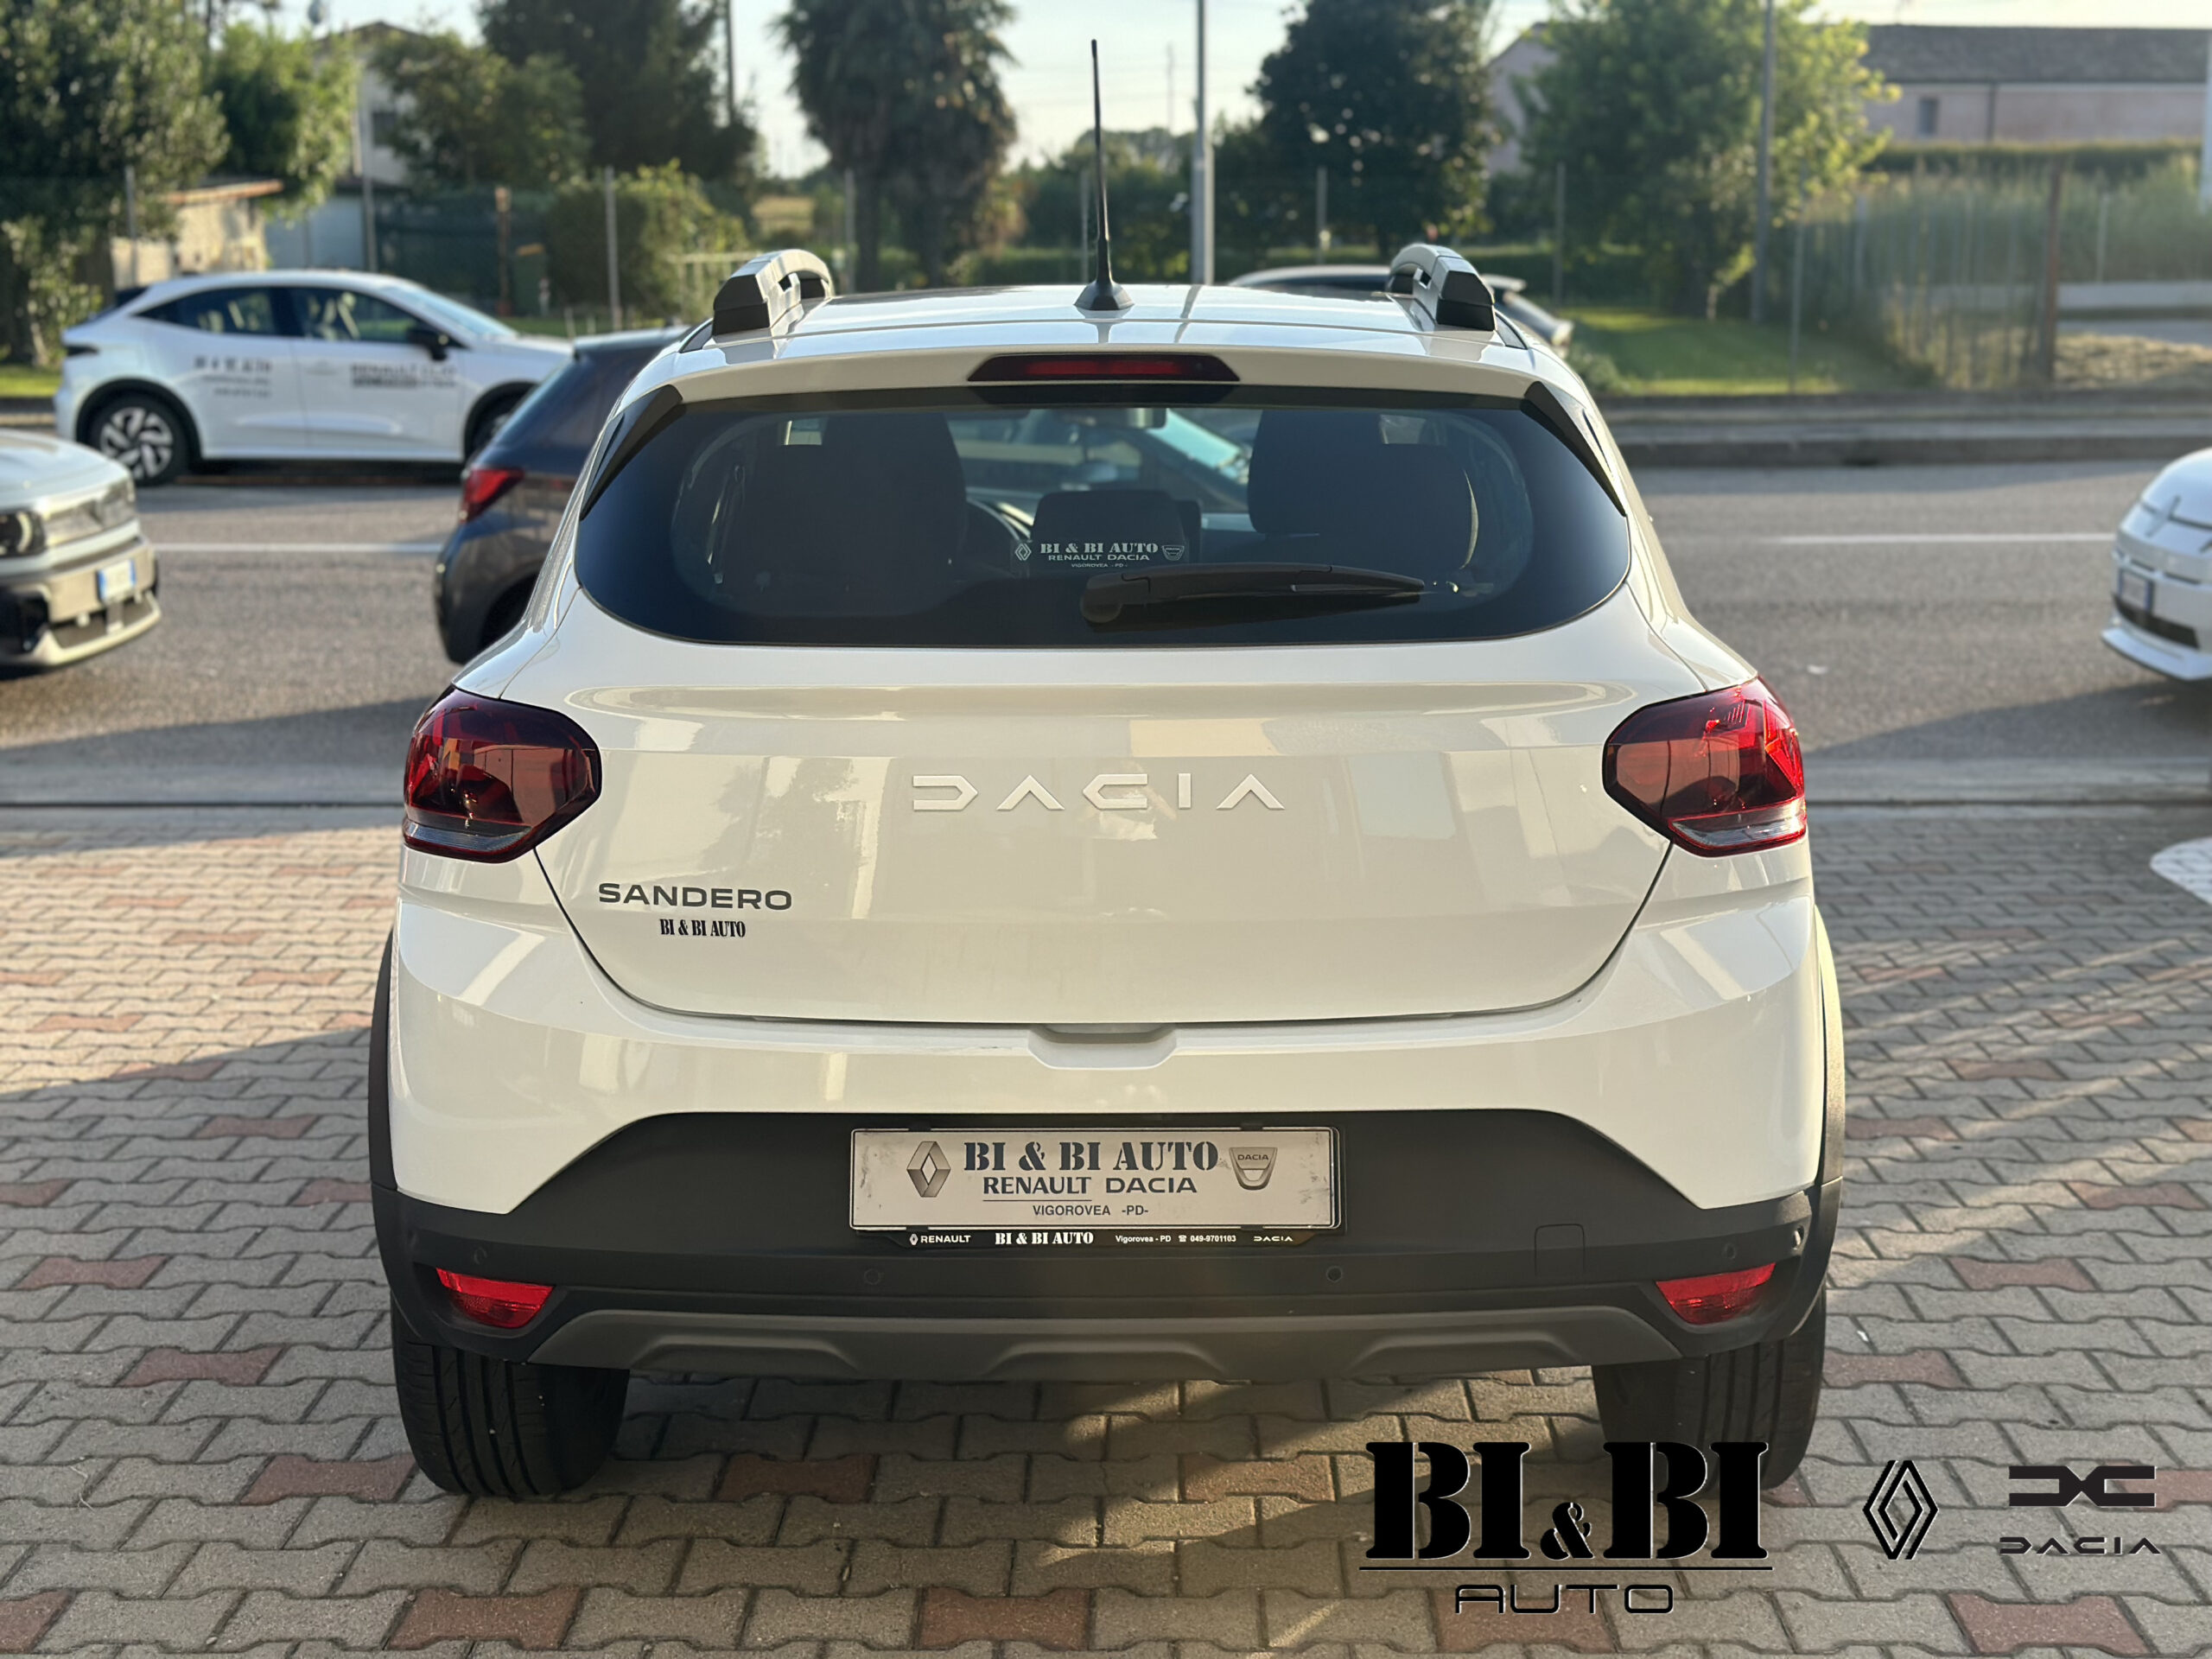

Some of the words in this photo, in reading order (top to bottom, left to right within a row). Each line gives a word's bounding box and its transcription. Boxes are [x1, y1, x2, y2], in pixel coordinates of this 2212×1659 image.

[1040, 543, 1059, 554] BI
[1065, 543, 1078, 553] &
[1084, 543, 1103, 553] BI
[1109, 543, 1159, 553] AUTO
[912, 773, 1286, 810] DACIA
[598, 882, 792, 911] SANDERO
[659, 918, 675, 935] BI
[677, 919, 689, 936] &
[691, 919, 707, 937] BI
[710, 920, 746, 938] AUTO
[963, 1141, 1006, 1171] BI
[1018, 1141, 1046, 1171] &
[1058, 1141, 1101, 1171] BI
[1113, 1141, 1218, 1171] AUTO
[982, 1176, 1092, 1195] RENAULT
[1105, 1177, 1198, 1194] DACIA
[1033, 1205, 1111, 1217] VIGOROVEA
[920, 1235, 971, 1244] RENAULT
[995, 1232, 1012, 1245] BI
[1015, 1232, 1027, 1245] &
[1031, 1232, 1049, 1245] BI
[1052, 1231, 1094, 1245] AUTO
[1115, 1235, 1154, 1244] Vigorovea
